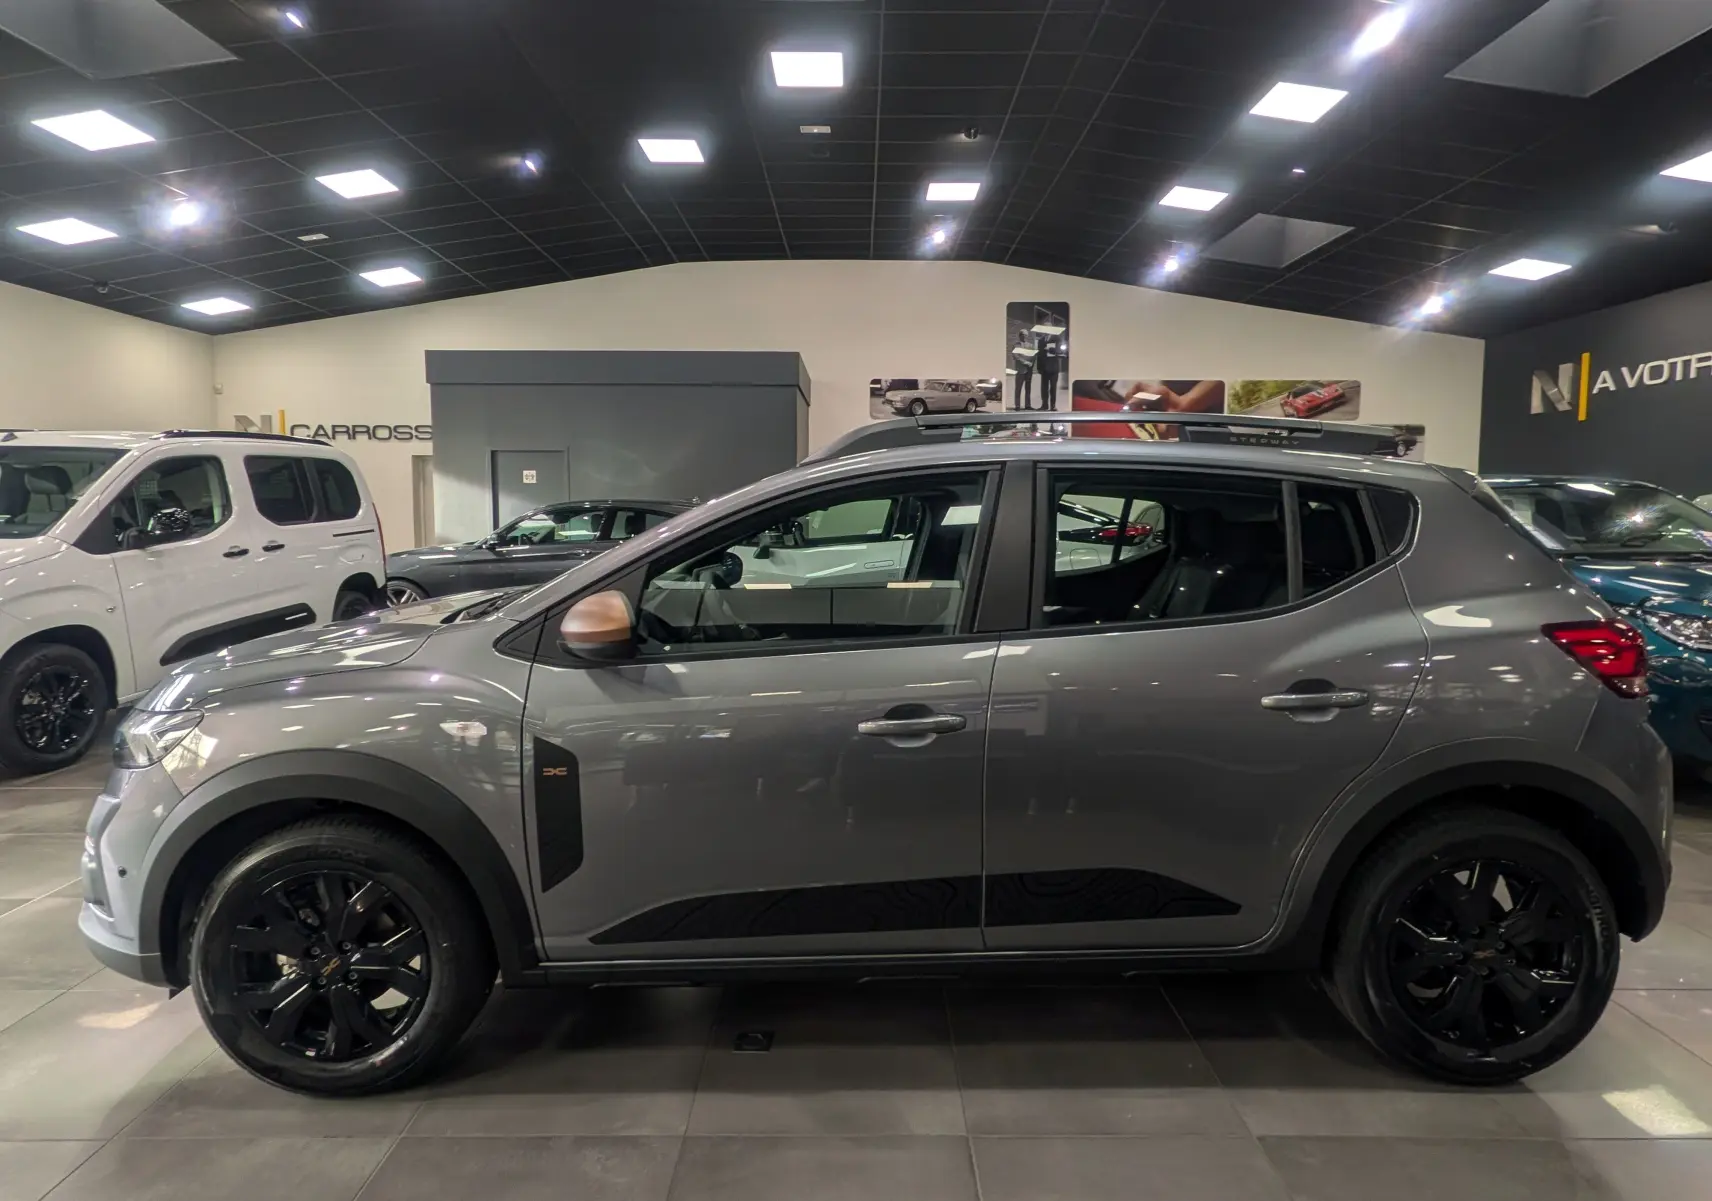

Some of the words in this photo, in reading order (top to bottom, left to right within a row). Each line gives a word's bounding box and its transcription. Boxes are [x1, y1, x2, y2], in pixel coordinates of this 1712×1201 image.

[1592, 370, 1617, 394] A
[290, 424, 432, 440] CARROSS
[1230, 437, 1299, 445] STEPWAY
